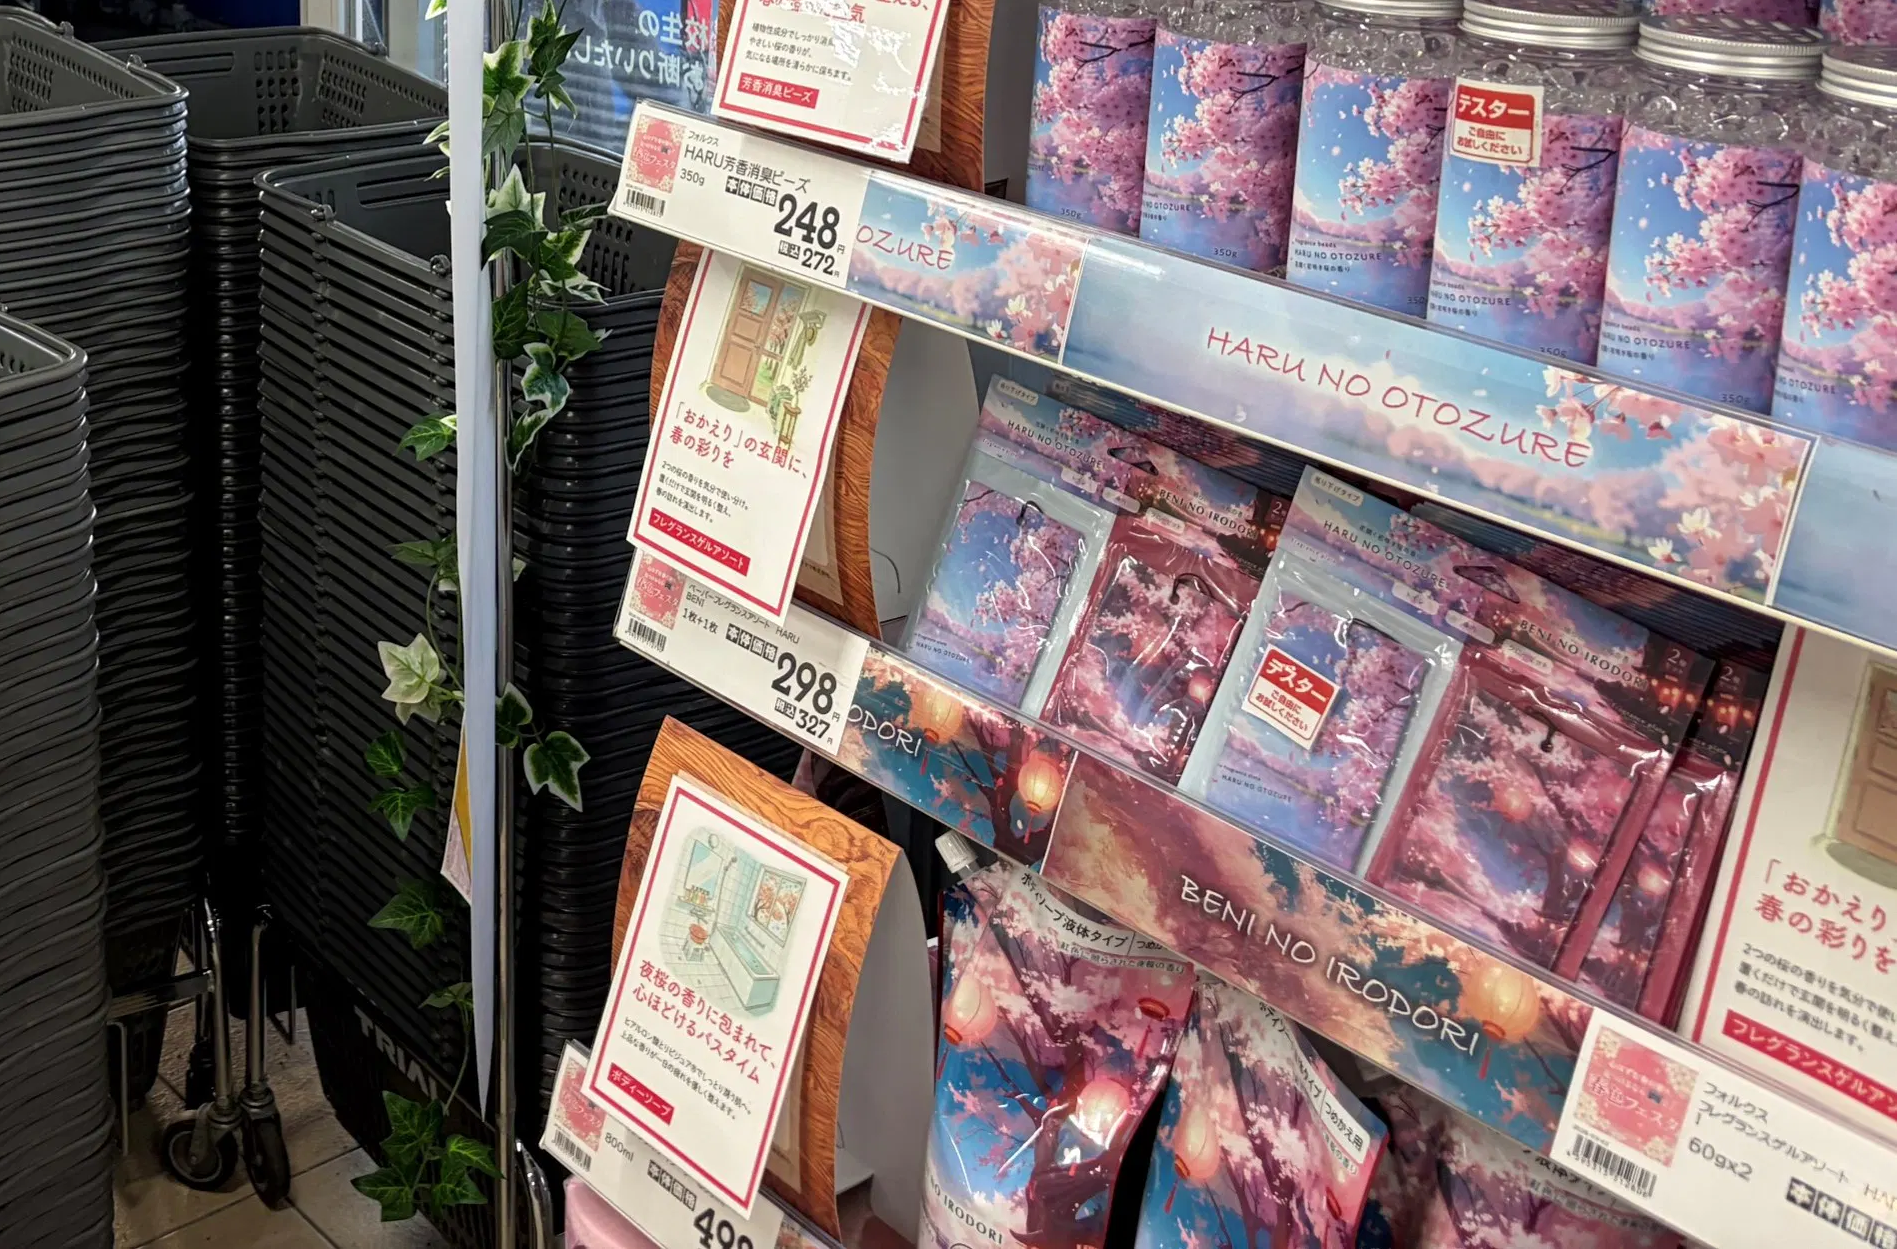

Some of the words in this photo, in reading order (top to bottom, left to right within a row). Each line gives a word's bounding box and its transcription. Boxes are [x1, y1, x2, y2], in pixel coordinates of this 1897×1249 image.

[741, 77, 814, 104] 芳香消臭ビーズ
[1457, 94, 1531, 120] テスター
[688, 131, 720, 148] フォルクス
[1456, 137, 1524, 157] お試しください
[1468, 126, 1507, 142] ご自由に
[680, 168, 706, 187] 350g
[684, 144, 811, 195] HARU芳香消臭ビーズ
[1061, 207, 1083, 220] 350g
[854, 222, 955, 272] OZURE
[1213, 247, 1239, 259] 350g
[1330, 252, 1383, 261] OTOZURE
[1458, 295, 1512, 307] OTOZURE
[1633, 337, 1692, 351] OTOZURE
[1206, 326, 1310, 385] HARU
[1316, 361, 1374, 399] NO
[1380, 380, 1593, 471] OTOZURE
[670, 425, 735, 470] 春の彩りを
[676, 401, 808, 480] 「おかえり」の玄関に、
[1007, 419, 1035, 440] HARU
[1038, 433, 1052, 447] NO
[1054, 439, 1104, 471] OTOZURE
[1187, 500, 1206, 516] NO
[652, 512, 744, 571] フレグランスゲルアソート
[1323, 519, 1359, 544] HARU
[1362, 538, 1380, 555] NO
[1384, 551, 1447, 589] OTOZURE
[682, 607, 718, 635] 1枚+1枚
[776, 626, 801, 645] HARU
[1519, 618, 1553, 641] BENI
[1558, 637, 1580, 656] NO
[1266, 658, 1328, 704] テスター
[1270, 688, 1303, 716] ご自由に
[847, 703, 922, 757] ODORI
[1253, 691, 1309, 734] お試しください
[1021, 872, 1129, 949] ボディソープ液体タイプ
[1755, 893, 1897, 975] 春の彩りを
[1180, 874, 1258, 938] BENI
[1263, 922, 1316, 965] NO
[1325, 958, 1481, 1056] IRODORI
[632, 982, 760, 1085] 心ほどけるバスタイム
[639, 959, 777, 1070] 夜桜の香りに包まれて、
[610, 1067, 672, 1119] ボディーソープ
[1703, 1081, 1769, 1125] フォルクス
[603, 1131, 635, 1163] 800ml
[1324, 1101, 1365, 1154] つめかえ用
[1698, 1100, 1850, 1183] フレグランスゲルアソート
[943, 1197, 1004, 1246] IRODORI
